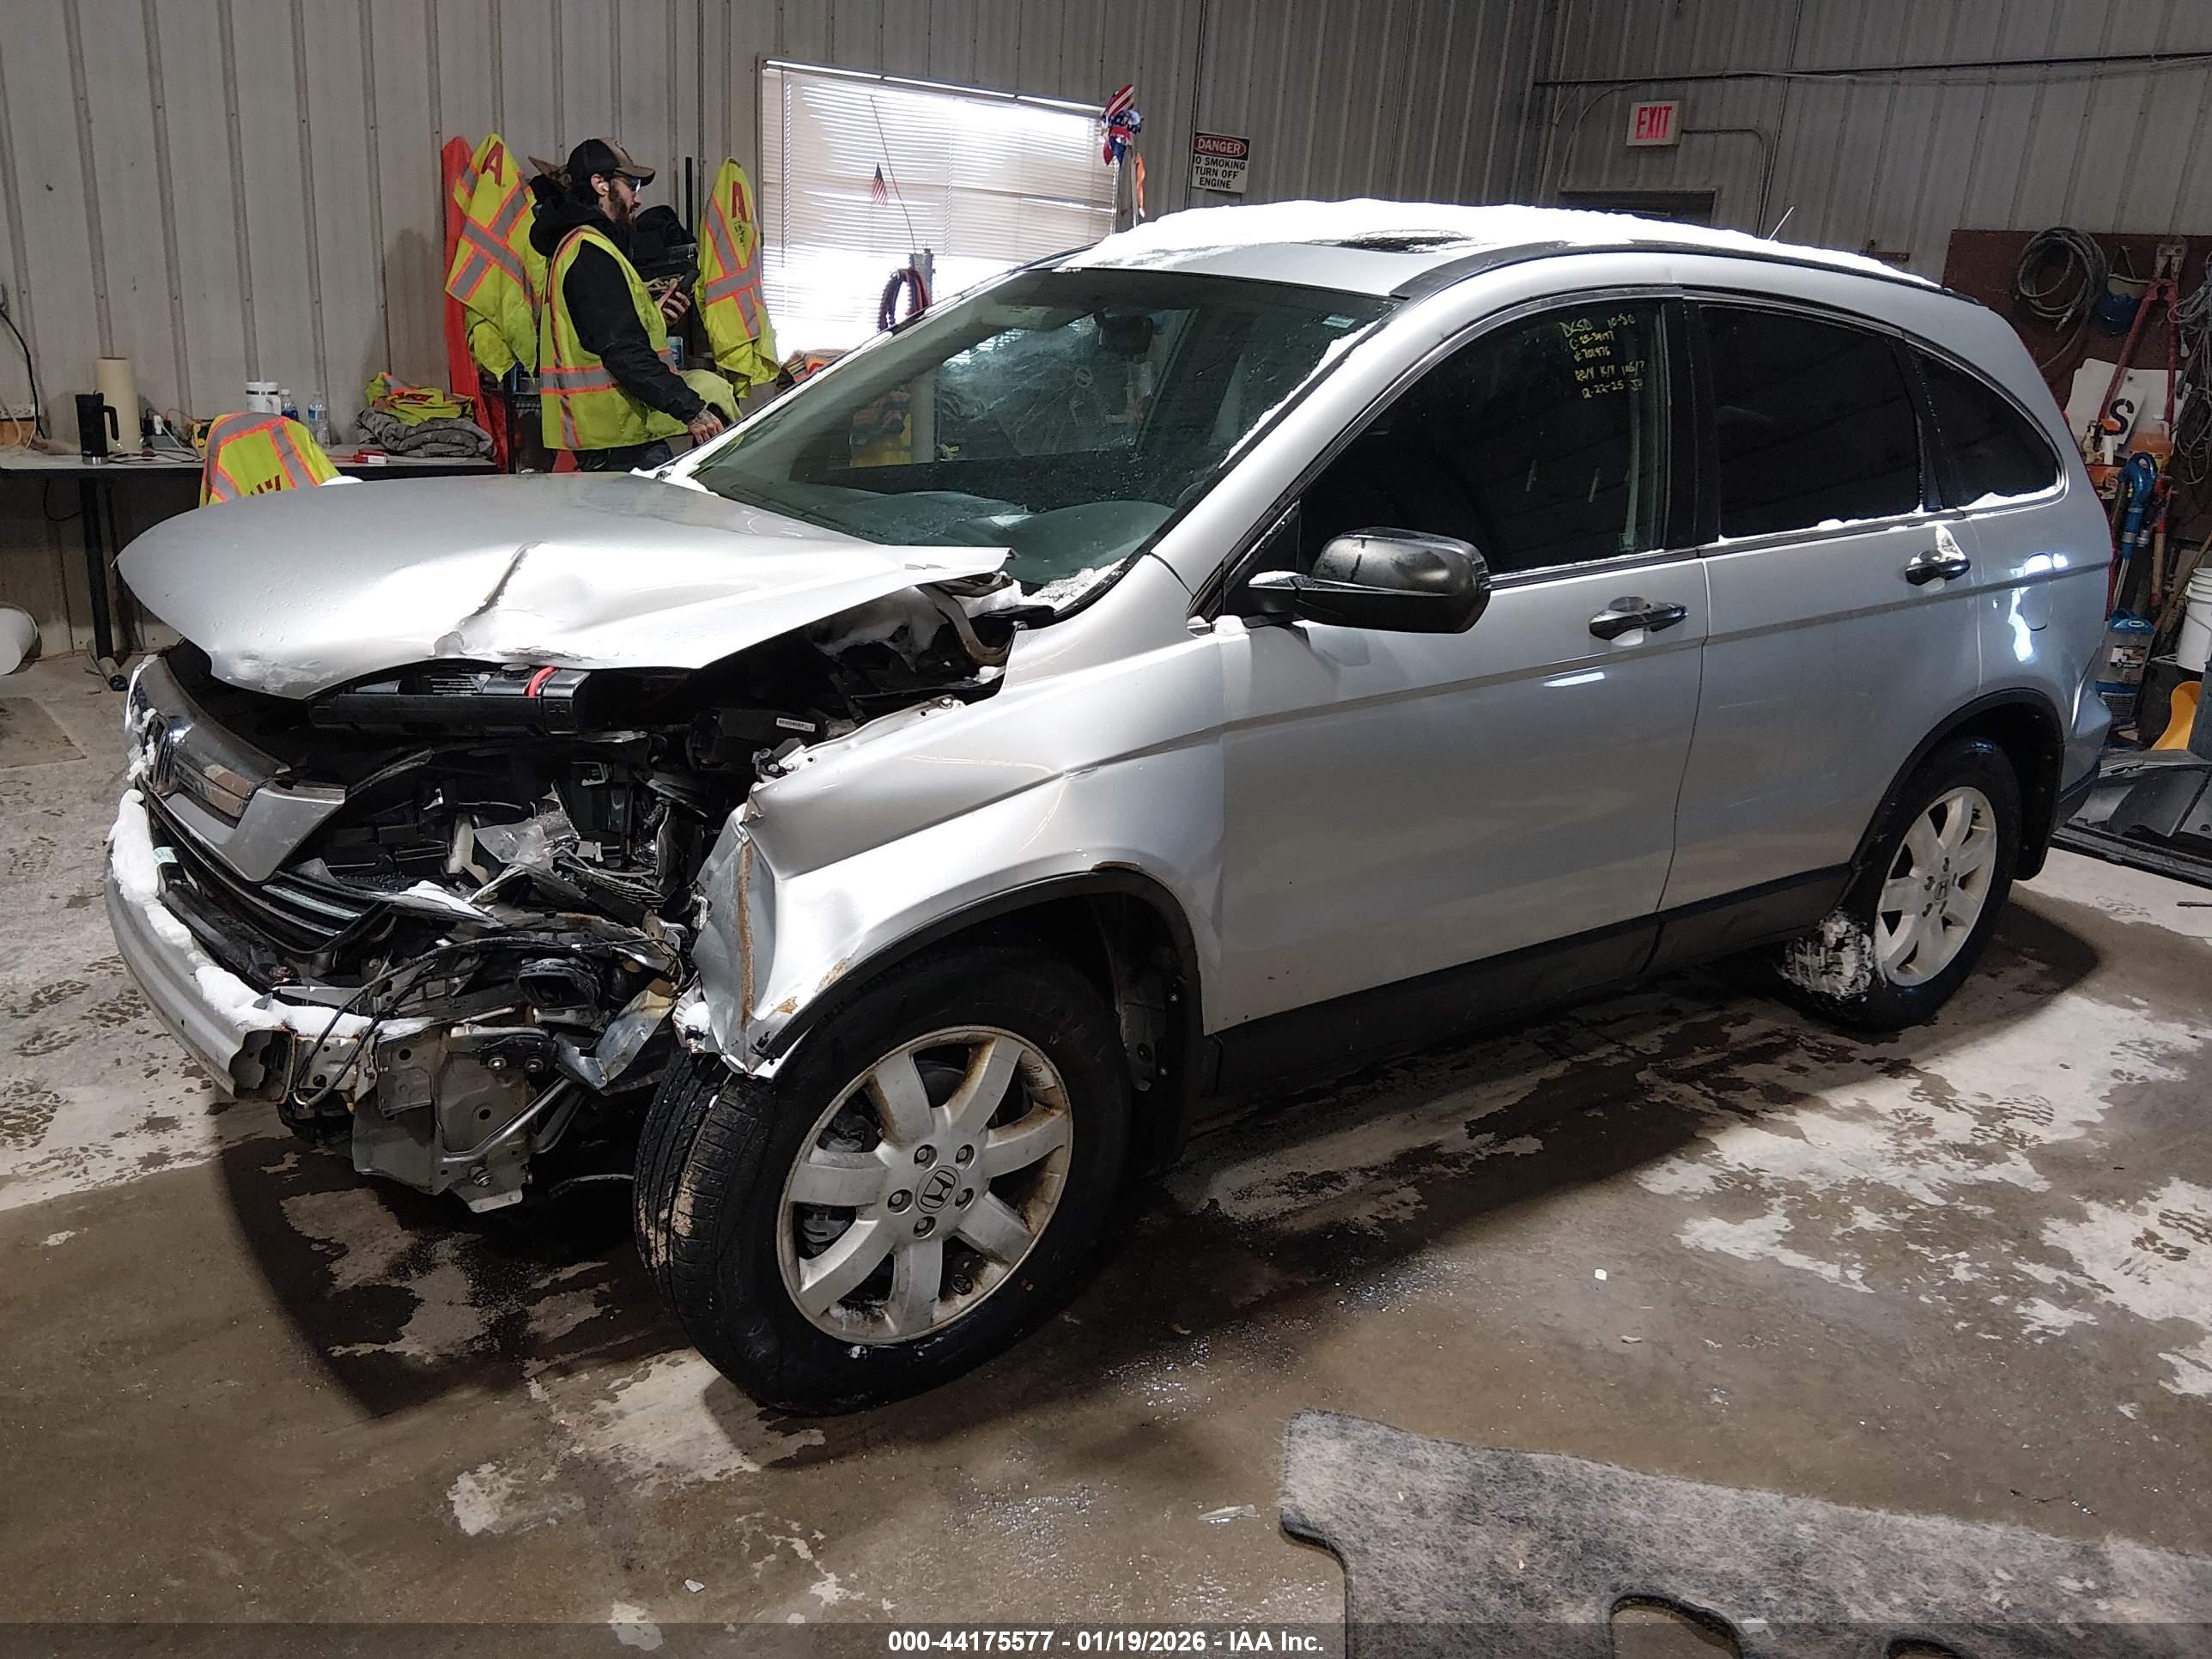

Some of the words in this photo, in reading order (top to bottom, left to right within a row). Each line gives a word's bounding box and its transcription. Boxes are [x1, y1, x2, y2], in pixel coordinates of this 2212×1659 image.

[1635, 106, 1672, 139] EXIT
[1198, 138, 1242, 155] DANGER
[481, 141, 503, 186] A
[1205, 157, 1245, 170] SMOKING
[1195, 166, 1218, 177] TURN
[1221, 169, 1239, 179] OFF
[1199, 177, 1231, 188] ENGINE
[2103, 398, 2134, 436] S
